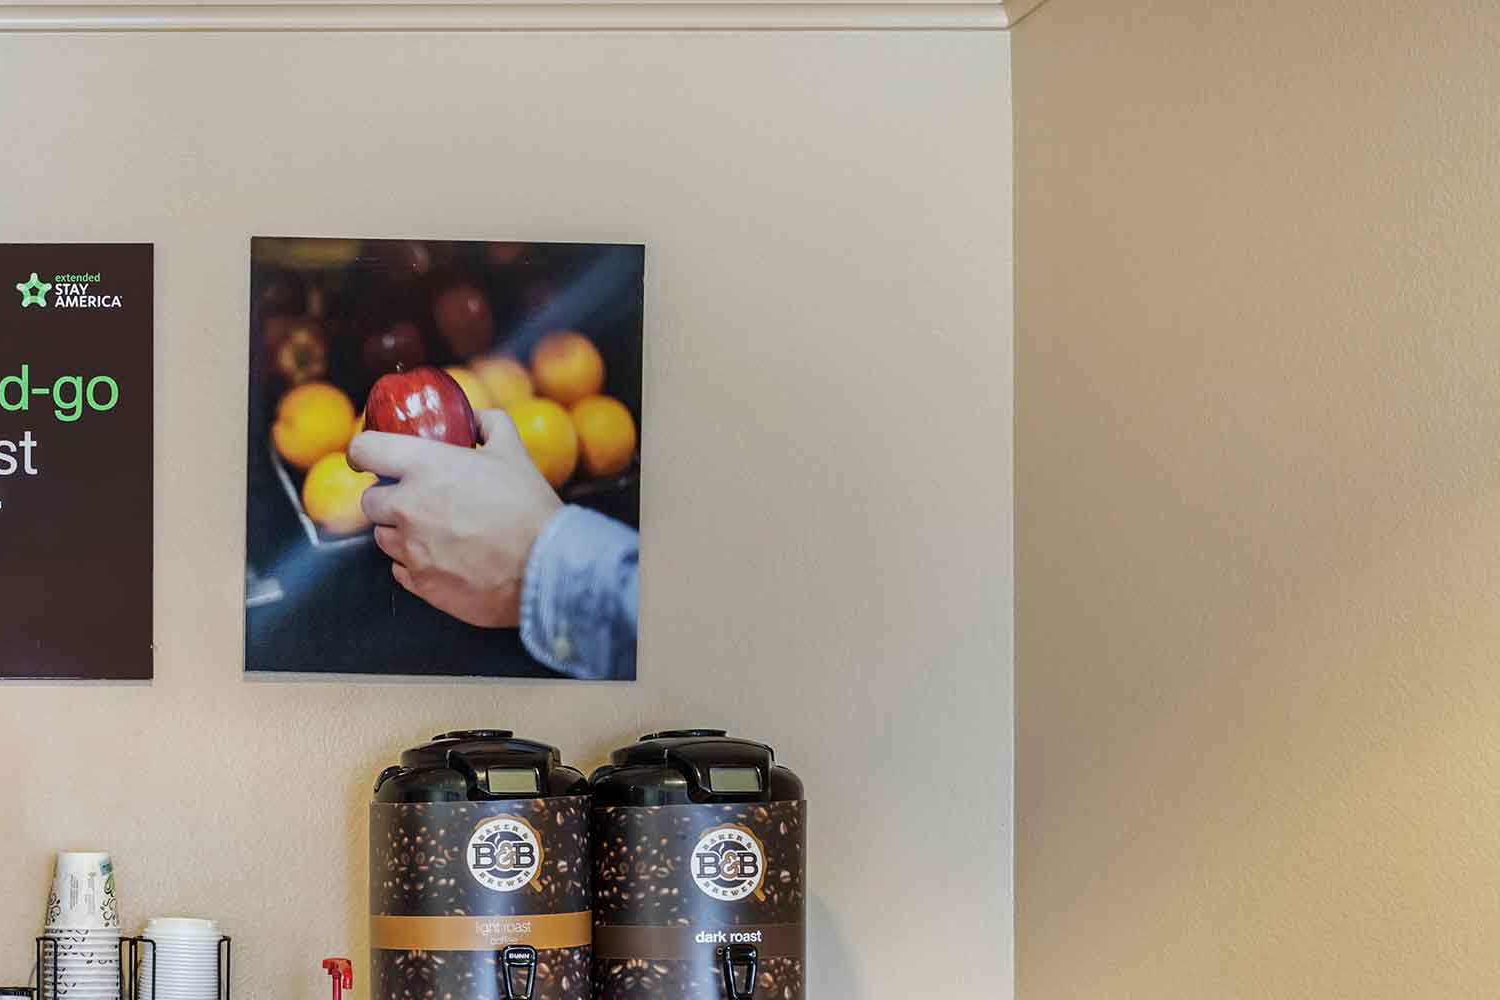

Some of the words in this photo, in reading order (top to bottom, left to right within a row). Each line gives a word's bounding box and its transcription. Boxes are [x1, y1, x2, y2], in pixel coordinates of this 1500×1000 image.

[55, 272, 101, 282] extended
[55, 283, 89, 295] STAY
[55, 295, 122, 308] AMERICA
[472, 842, 536, 869] B&B
[696, 852, 759, 878] B&B
[695, 931, 727, 943] dark
[730, 930, 762, 942] roast
